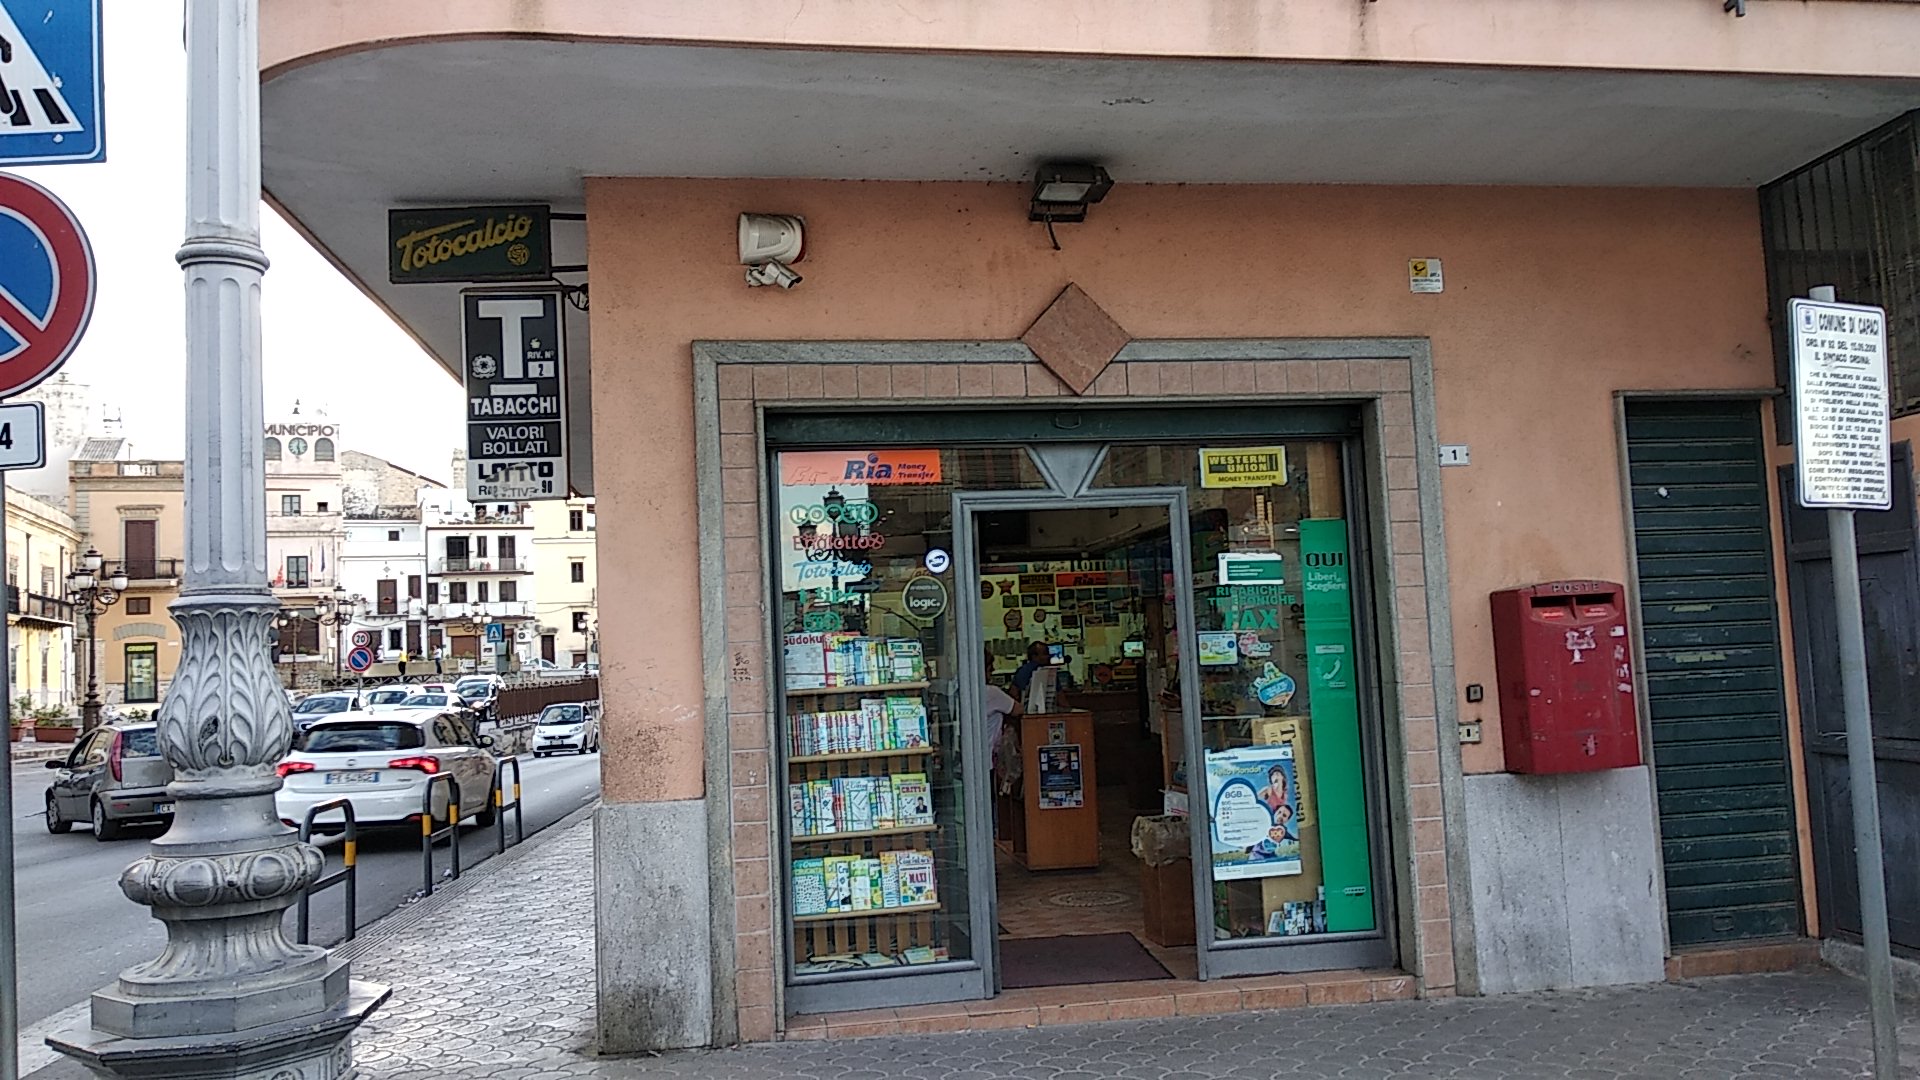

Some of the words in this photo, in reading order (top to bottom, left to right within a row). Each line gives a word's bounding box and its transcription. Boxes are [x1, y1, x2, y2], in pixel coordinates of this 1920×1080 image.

[396, 214, 534, 272] Totocalcio
[1848, 316, 1856, 334] DI
[478, 300, 544, 379] T
[538, 363, 544, 377] 2
[470, 396, 558, 417] TABACCHI
[264, 424, 334, 437] MUNICIPIO
[486, 426, 545, 441] VALORI
[482, 440, 549, 456] BOLLATI
[1209, 455, 1267, 465] WESTERN
[1452, 450, 1457, 461] 1
[844, 453, 892, 480] Ria
[897, 463, 927, 472] Money
[1227, 463, 1268, 473] UNION
[898, 471, 935, 480] Transfer
[1218, 475, 1242, 483] MONEY
[1243, 474, 1277, 482] TRANSFER
[1305, 552, 1344, 569] QUI
[1308, 571, 1337, 581] Liberi
[1552, 583, 1600, 593] POSTE
[356, 634, 366, 644] 20
